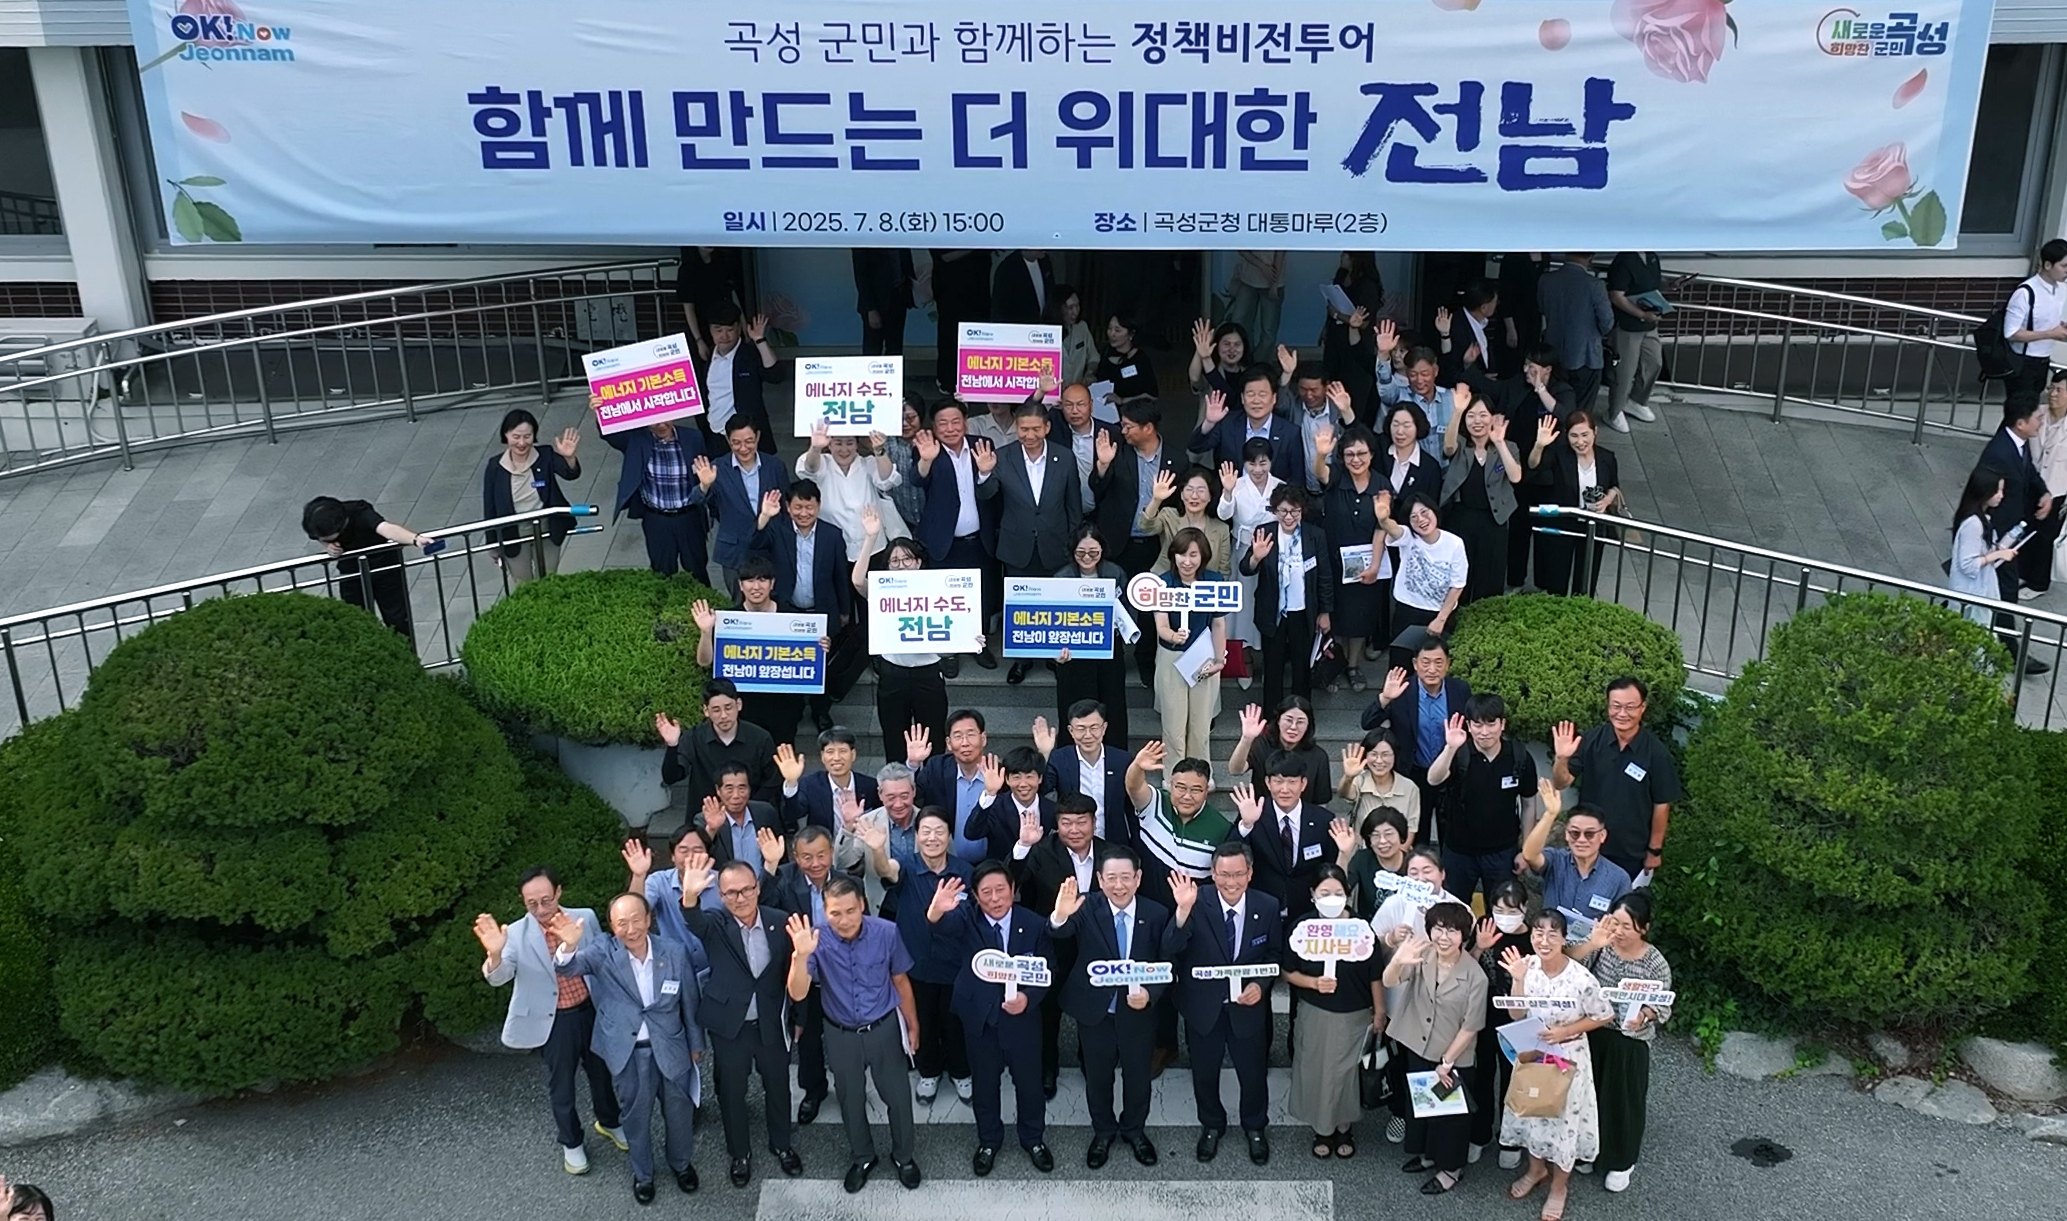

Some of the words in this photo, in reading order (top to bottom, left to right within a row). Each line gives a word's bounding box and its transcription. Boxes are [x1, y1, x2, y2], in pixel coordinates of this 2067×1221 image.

[171, 14, 233, 41] OK!
[236, 23, 291, 41] Now
[1831, 20, 1886, 40] 새로운
[1886, 12, 1949, 56] 곡성
[724, 22, 801, 64] 곡성
[818, 22, 941, 63] 군민과
[953, 21, 1116, 63] 함께하는
[1131, 21, 1375, 64] 정책비전투어
[1829, 42, 1870, 56] 희망찬
[1874, 41, 1904, 56] 군민
[179, 44, 295, 61] Jeonnam
[467, 86, 648, 169] 함께
[672, 90, 923, 171] 만드는
[951, 91, 1028, 169] 더
[1055, 88, 1318, 171] 위대한
[1341, 76, 1636, 191] 전남
[722, 211, 766, 232] 일시
[782, 212, 848, 232] 2025.
[853, 212, 873, 232] 7.
[942, 212, 1004, 232] 15:00
[1094, 212, 1137, 233] 장소
[1154, 212, 1240, 233] 곡성군청
[1247, 212, 1388, 234] 대통마루(2층)
[967, 356, 1003, 370] 에너지
[600, 380, 637, 400] 에너지
[637, 368, 687, 391] 기본소득
[805, 382, 852, 397] 에너지
[857, 382, 892, 398] 수도,
[961, 375, 1003, 388] 전남에서
[1005, 376, 1057, 389] 시작합
[600, 398, 642, 420] 전남에서
[644, 387, 696, 410] 시작합니다
[823, 400, 875, 425] 전남
[880, 597, 928, 613] 에너지
[934, 596, 971, 613] 수도,
[1139, 587, 1190, 607] 희망찬
[1195, 586, 1238, 607] 군민
[1013, 611, 1051, 625] 에너지
[1054, 612, 1105, 626] 기본소득
[898, 615, 953, 642] 전남
[1012, 630, 1046, 643] 전남이
[1048, 631, 1104, 644] 앞장섭니다
[723, 645, 762, 660] 에너지
[765, 646, 816, 662] 기본소득
[723, 664, 756, 678] 전남이
[759, 665, 815, 679] 앞장섭니다
[1307, 924, 1359, 938] 환영해요
[1304, 939, 1352, 955] 지사님
[1017, 960, 1044, 971] 곡성
[1092, 963, 1131, 975] OK!
[1134, 966, 1168, 975] Now
[1021, 971, 1048, 984] 군민
[1094, 975, 1169, 984] Jeonnam
